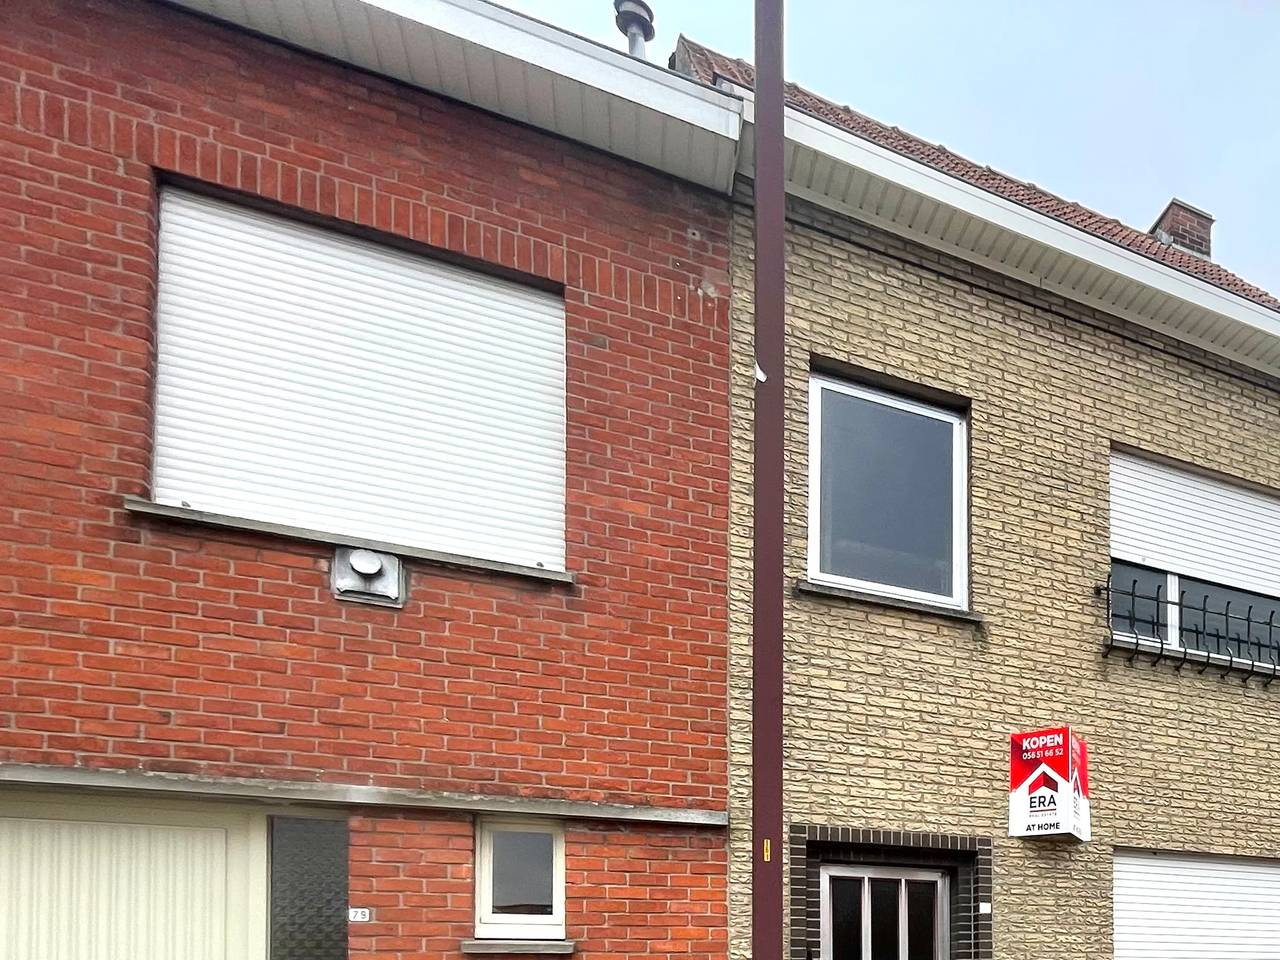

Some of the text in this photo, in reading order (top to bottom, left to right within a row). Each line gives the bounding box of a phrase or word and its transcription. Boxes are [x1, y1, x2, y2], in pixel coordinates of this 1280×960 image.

[1022, 733, 1063, 750] KOPEN
[1036, 750, 1044, 758] 51
[1055, 747, 1064, 756] 52
[1029, 794, 1057, 808] ERA
[1037, 822, 1060, 831] HOME
[353, 910, 367, 919] 79
